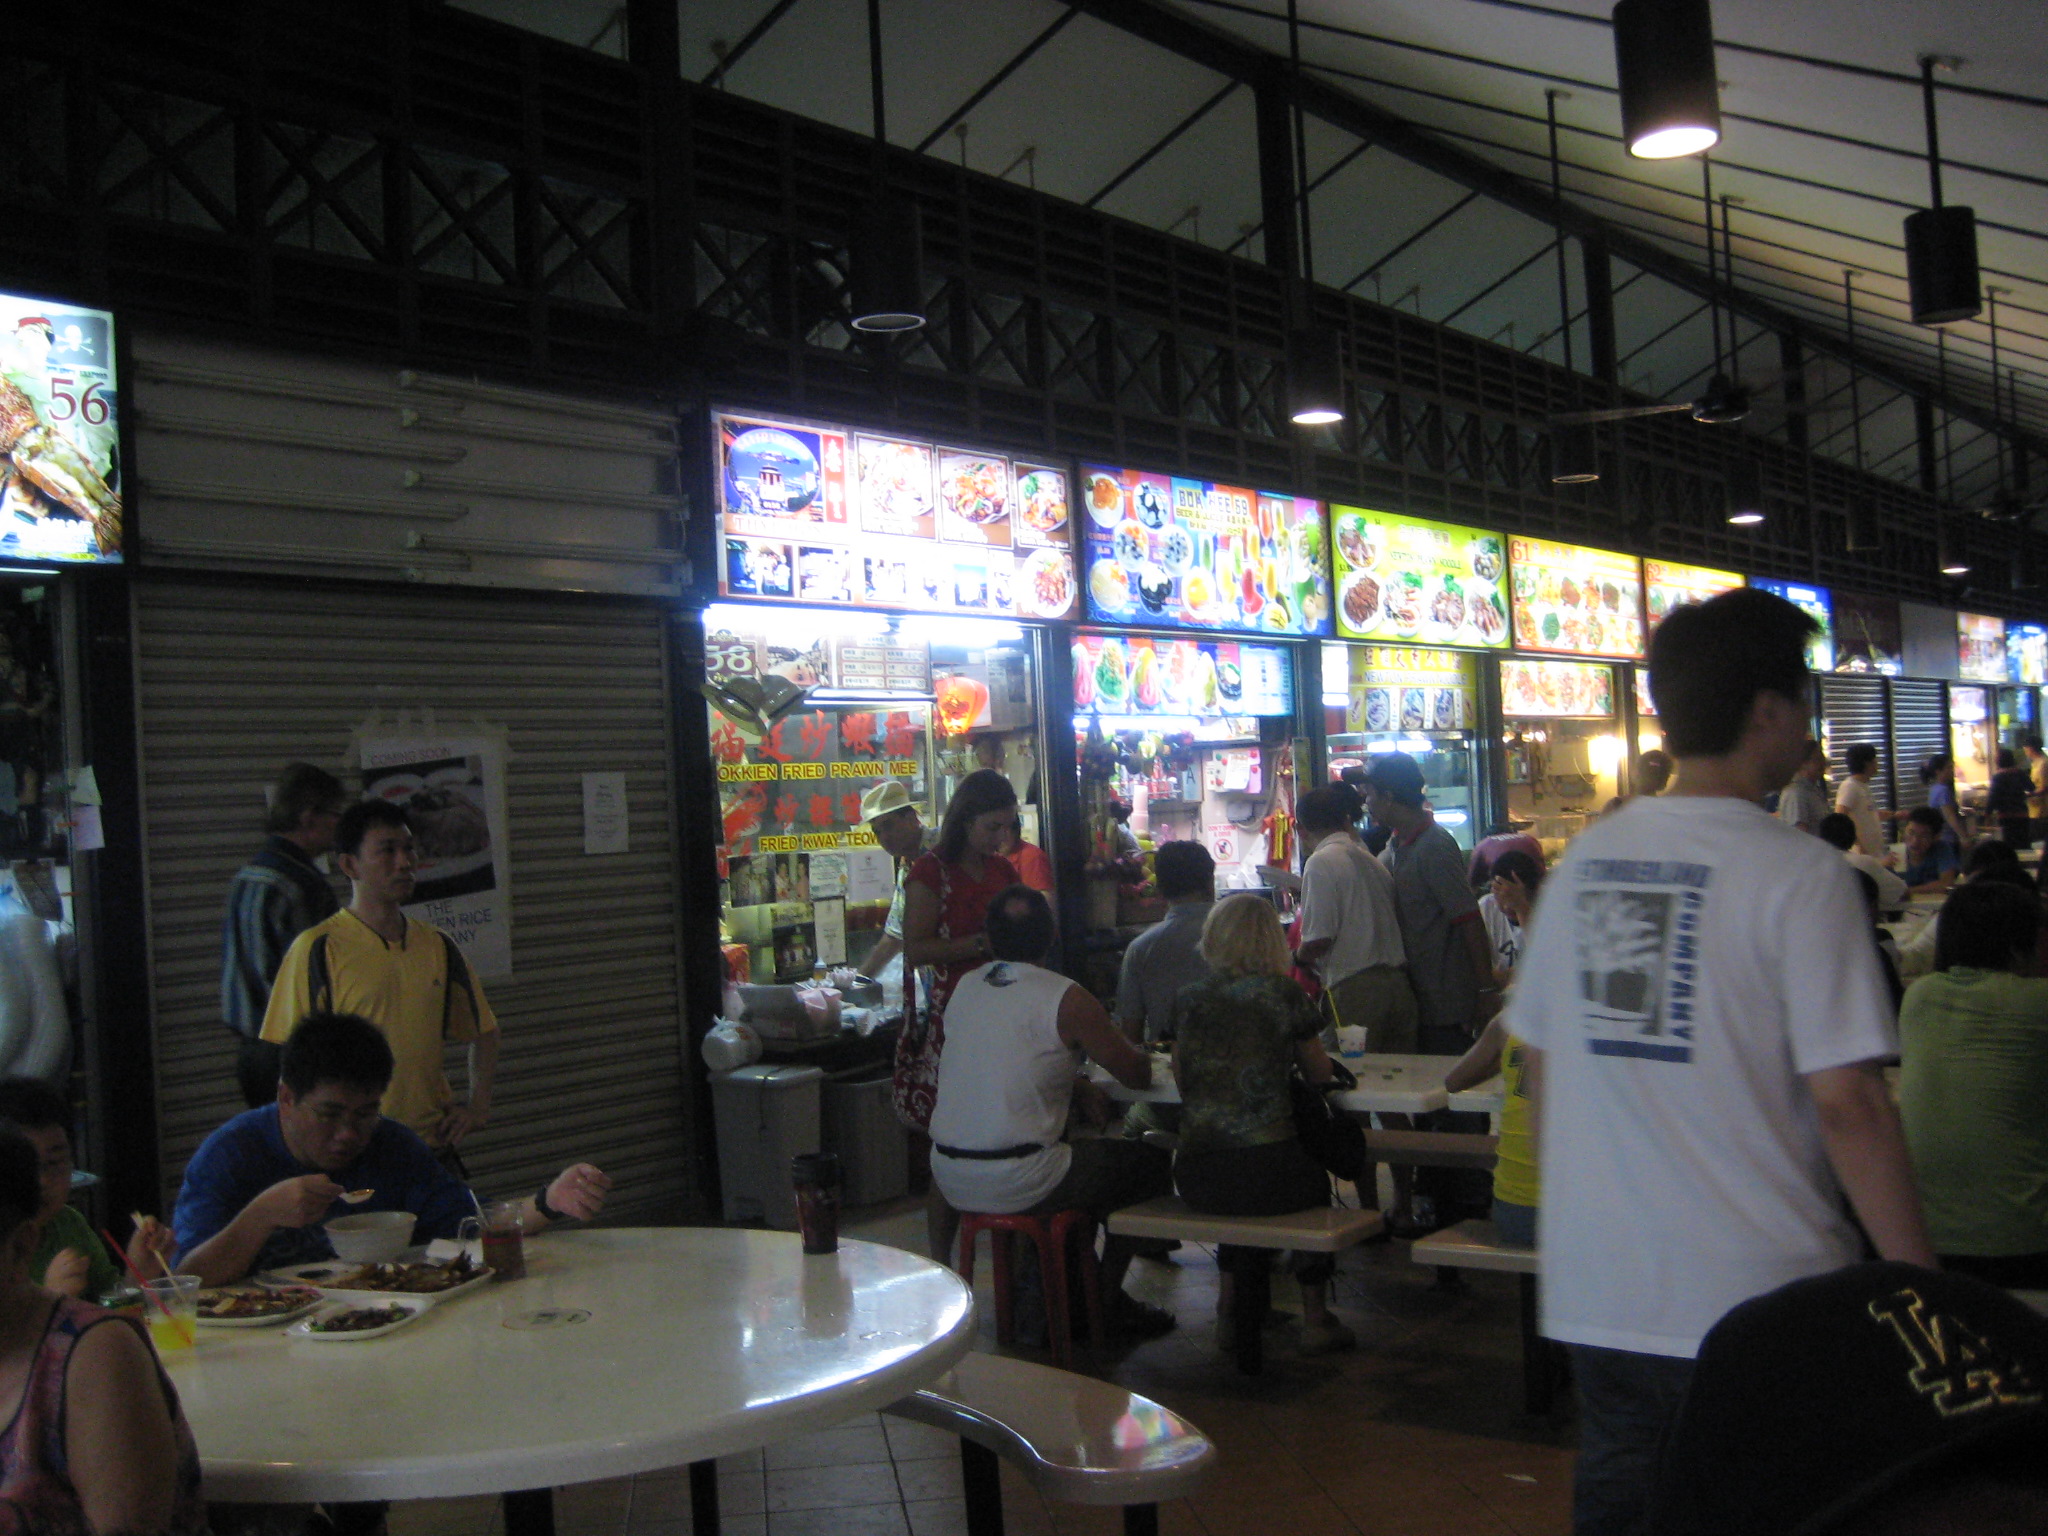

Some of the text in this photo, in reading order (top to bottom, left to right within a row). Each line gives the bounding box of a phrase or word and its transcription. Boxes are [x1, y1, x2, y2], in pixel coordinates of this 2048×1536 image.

[49, 377, 109, 425] 56
[1510, 540, 1531, 562] 61
[1646, 563, 1662, 582] 62
[1365, 671, 1403, 684] NEWTON
[718, 760, 918, 781] OKKIEN FRIED PRAWN MEE
[759, 836, 798, 852] FRIED
[803, 833, 842, 850] KWAY
[425, 900, 453, 918] THE
[459, 909, 492, 925] RICE
